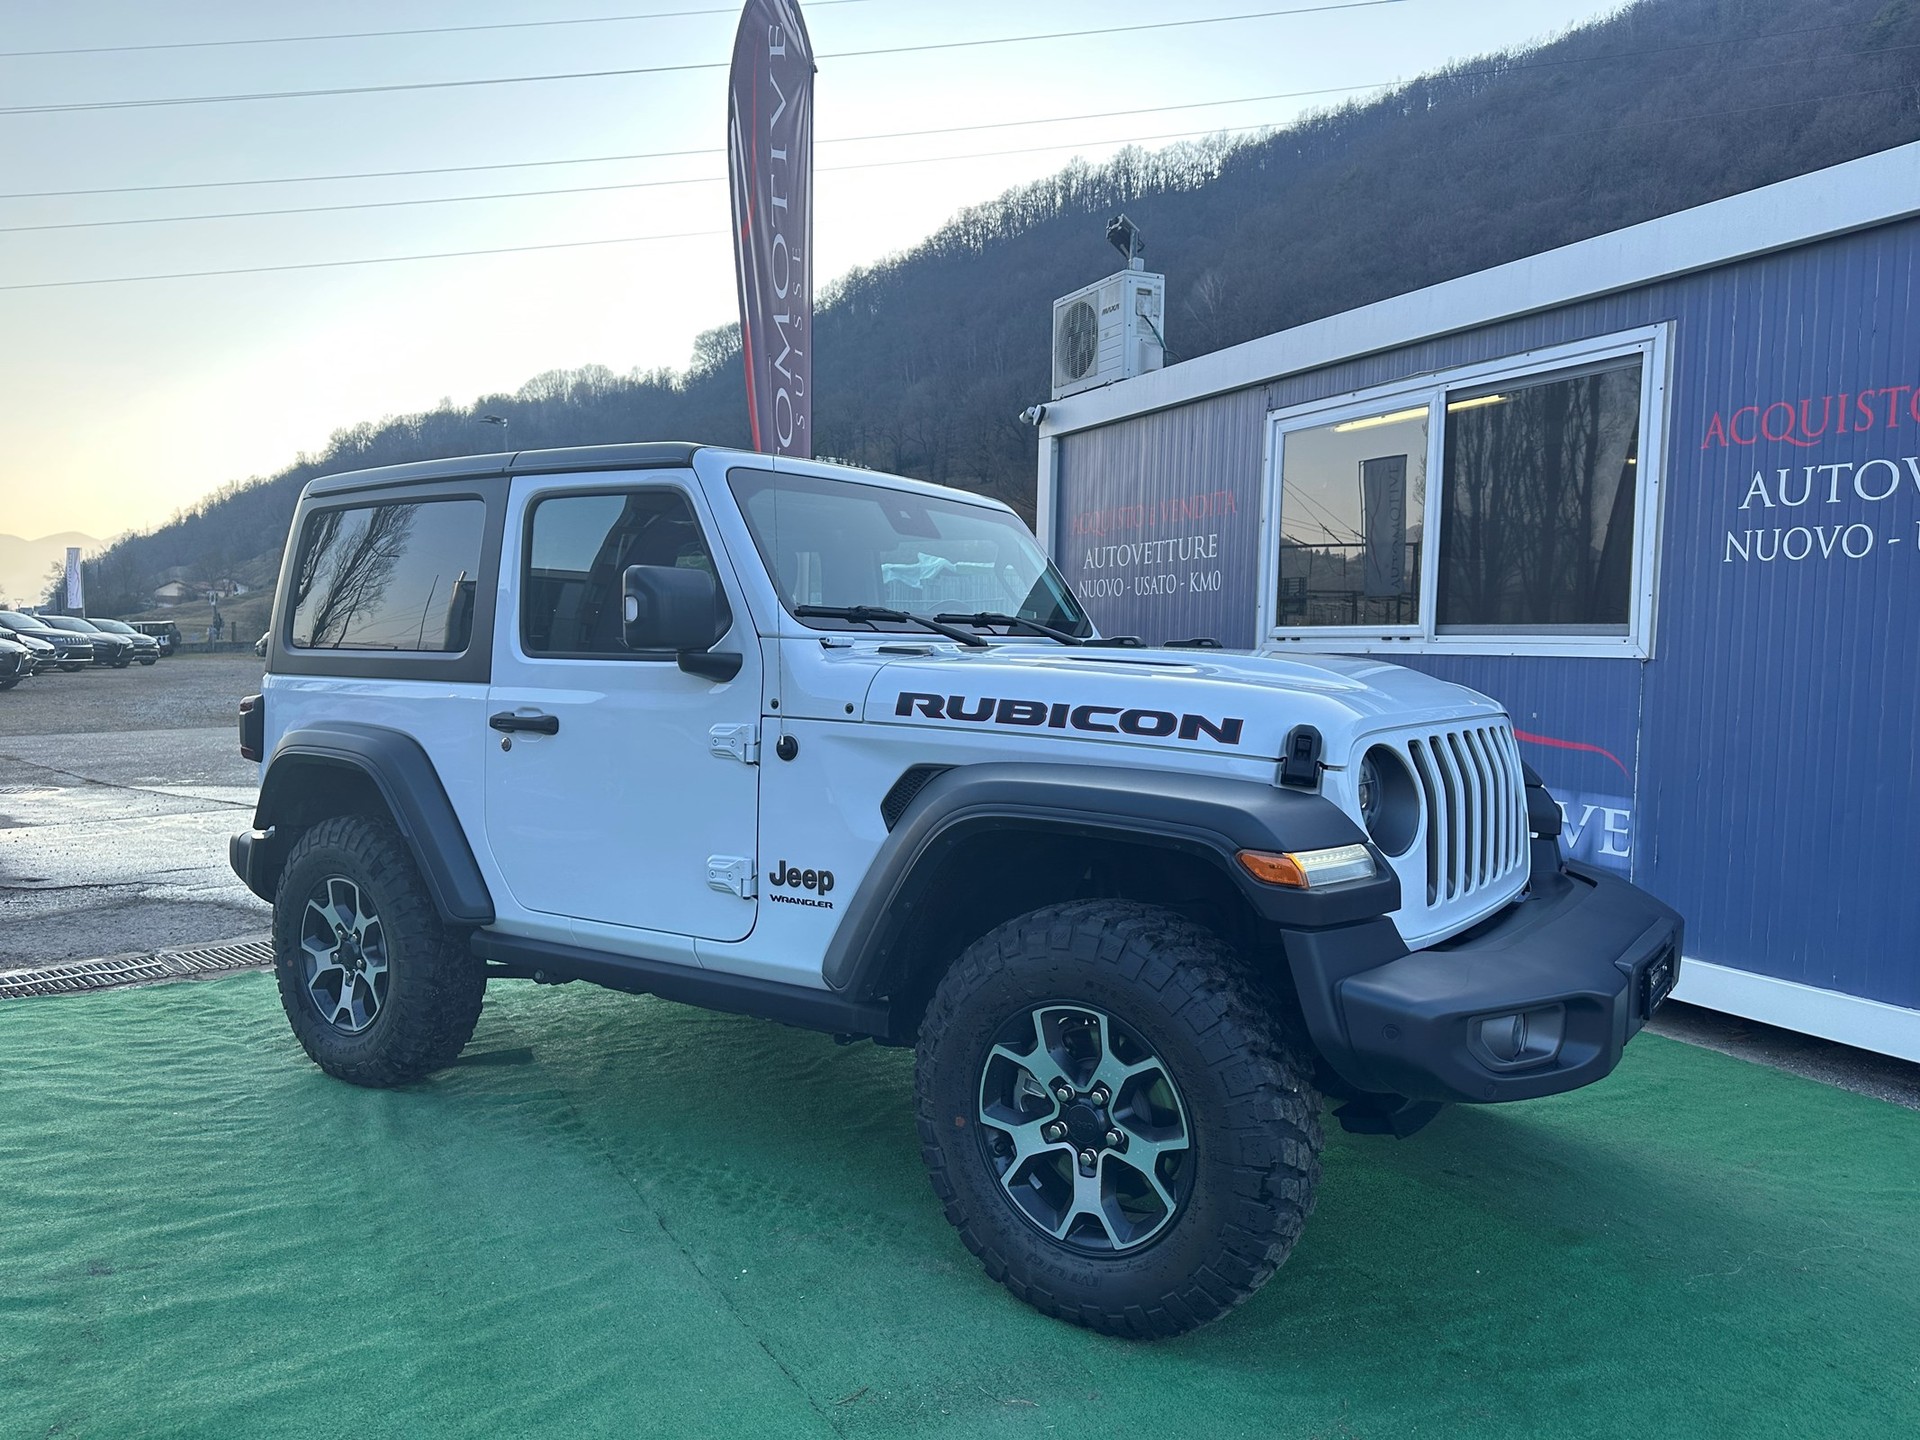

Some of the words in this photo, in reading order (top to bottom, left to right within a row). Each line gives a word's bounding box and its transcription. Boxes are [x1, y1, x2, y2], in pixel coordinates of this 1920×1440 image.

[768, 22, 793, 456] OMOTIVE
[792, 247, 806, 430] SUISSE
[1701, 385, 1920, 450] ACQUIST
[1083, 534, 1218, 570] AUTOVETTURE
[1723, 523, 1874, 563] NUOVO
[1078, 577, 1124, 599] NUOVO
[1134, 573, 1177, 597] USATO
[894, 691, 1244, 746] RUBICON
[769, 859, 835, 896] Jeep
[769, 894, 834, 910] WRANGLER
